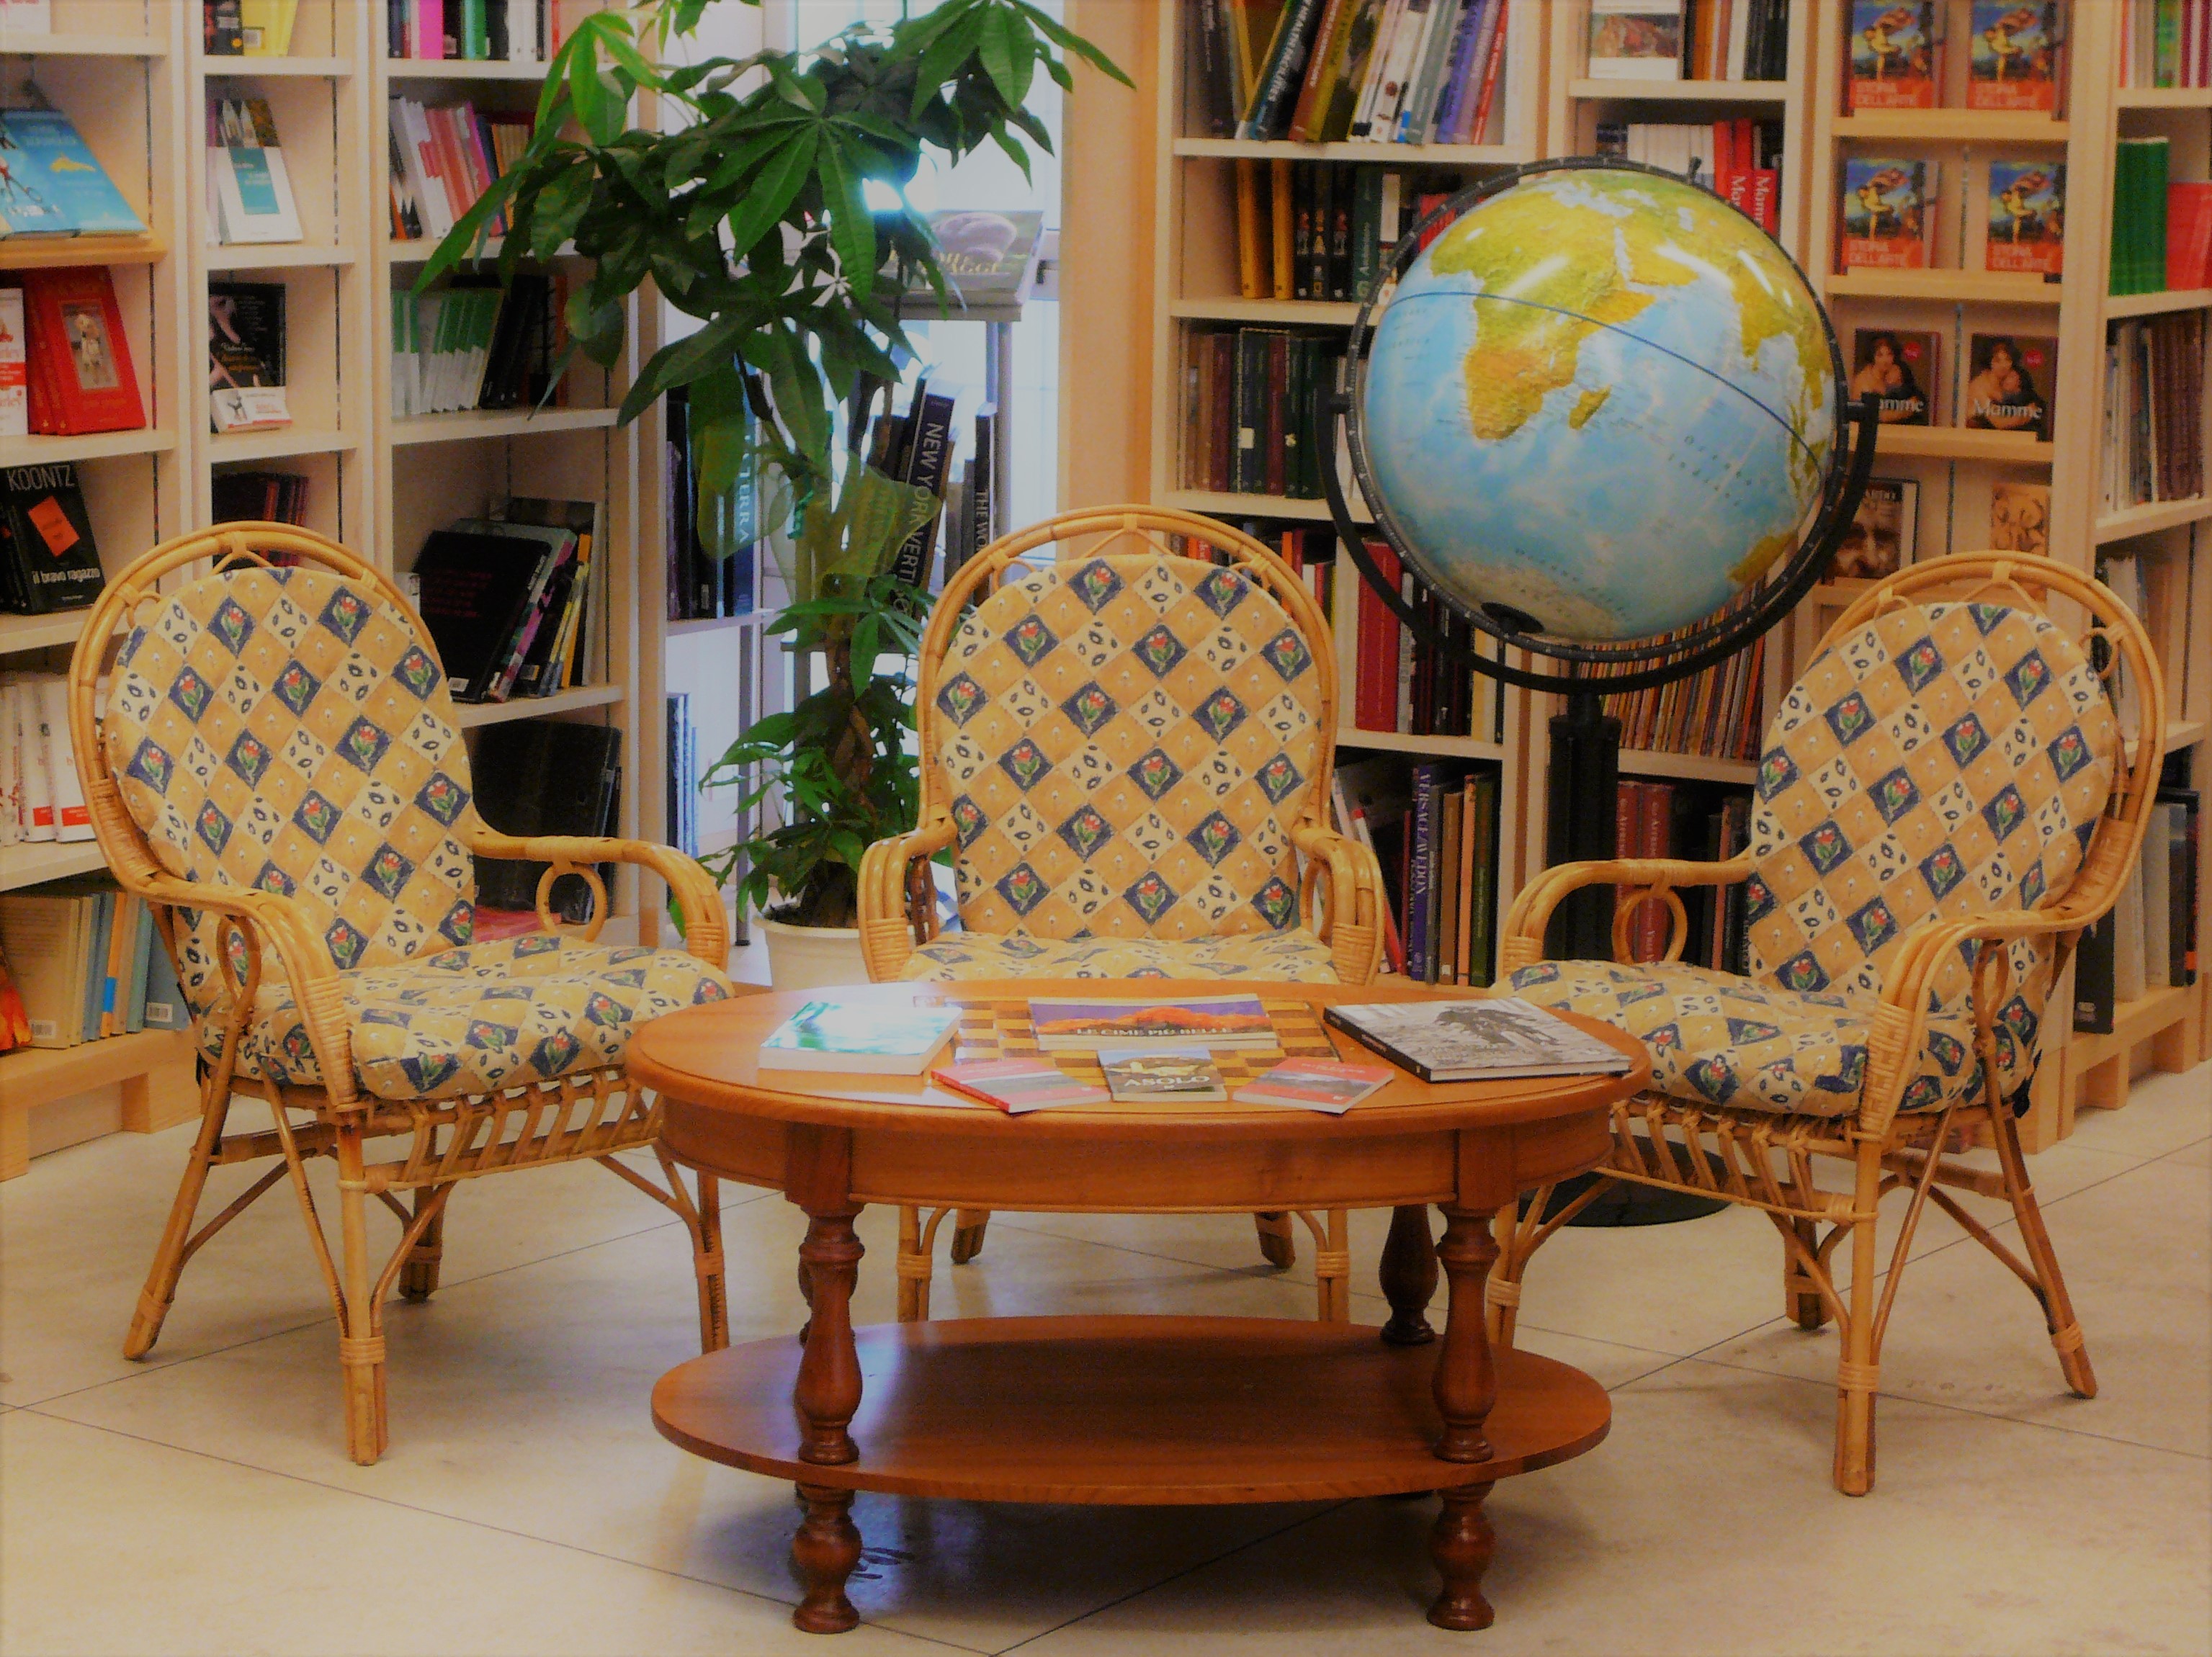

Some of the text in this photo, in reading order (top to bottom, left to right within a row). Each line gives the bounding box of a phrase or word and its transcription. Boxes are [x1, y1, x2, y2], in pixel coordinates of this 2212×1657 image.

[1974, 398, 2043, 419] Mamme
[7, 465, 74, 491] KOONTZ
[975, 489, 989, 517] THE
[893, 422, 944, 614] NEW YORK VERTIO
[1124, 1075, 1211, 1086] ASOLO
